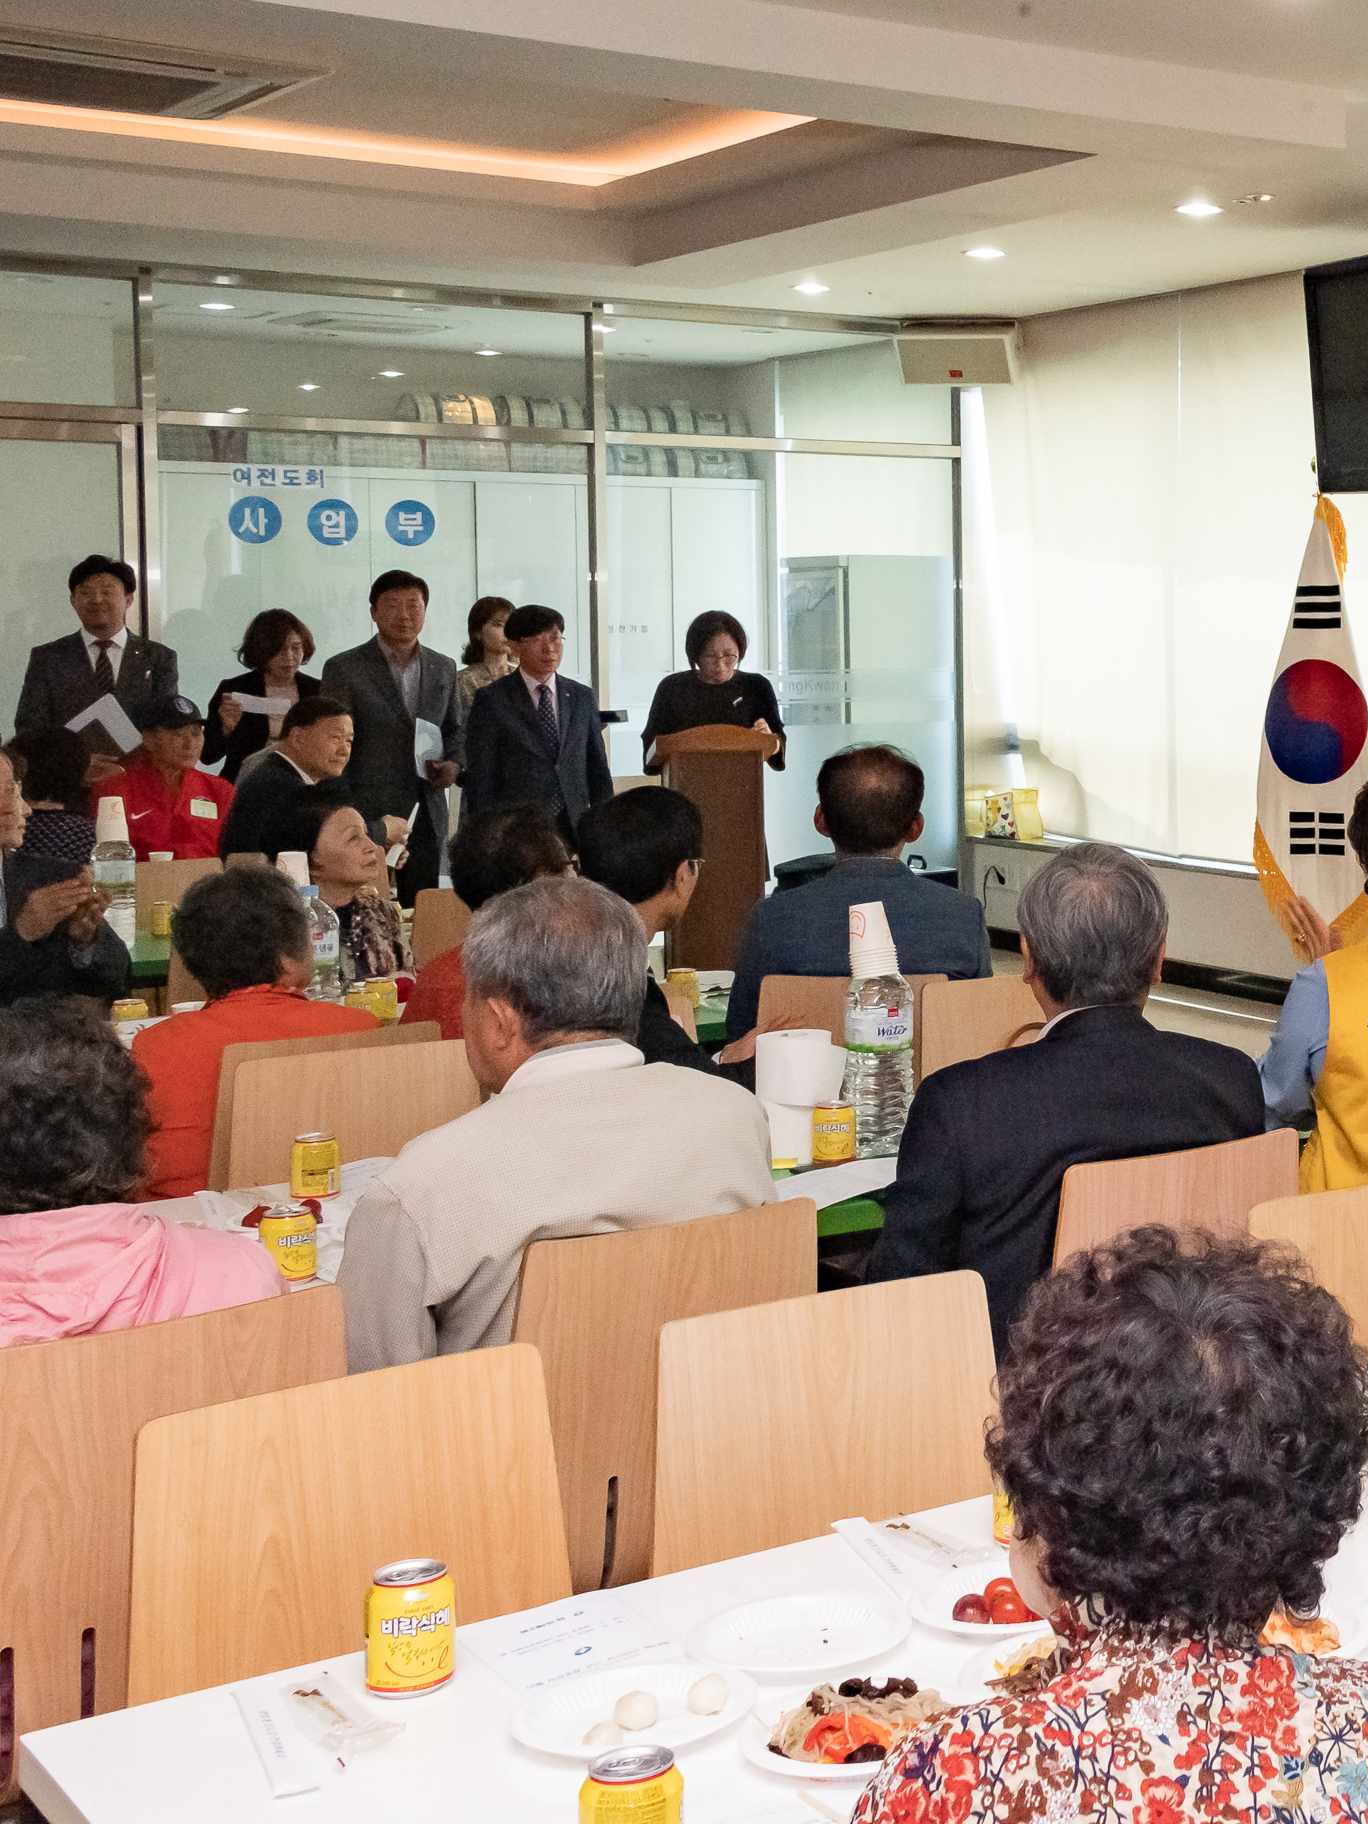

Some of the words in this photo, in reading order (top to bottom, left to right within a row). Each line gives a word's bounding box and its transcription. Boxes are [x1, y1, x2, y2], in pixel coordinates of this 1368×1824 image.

[232, 466, 325, 488] 여전도회
[877, 1025, 908, 1037] Water
[380, 1605, 451, 1638] 비락식혜
